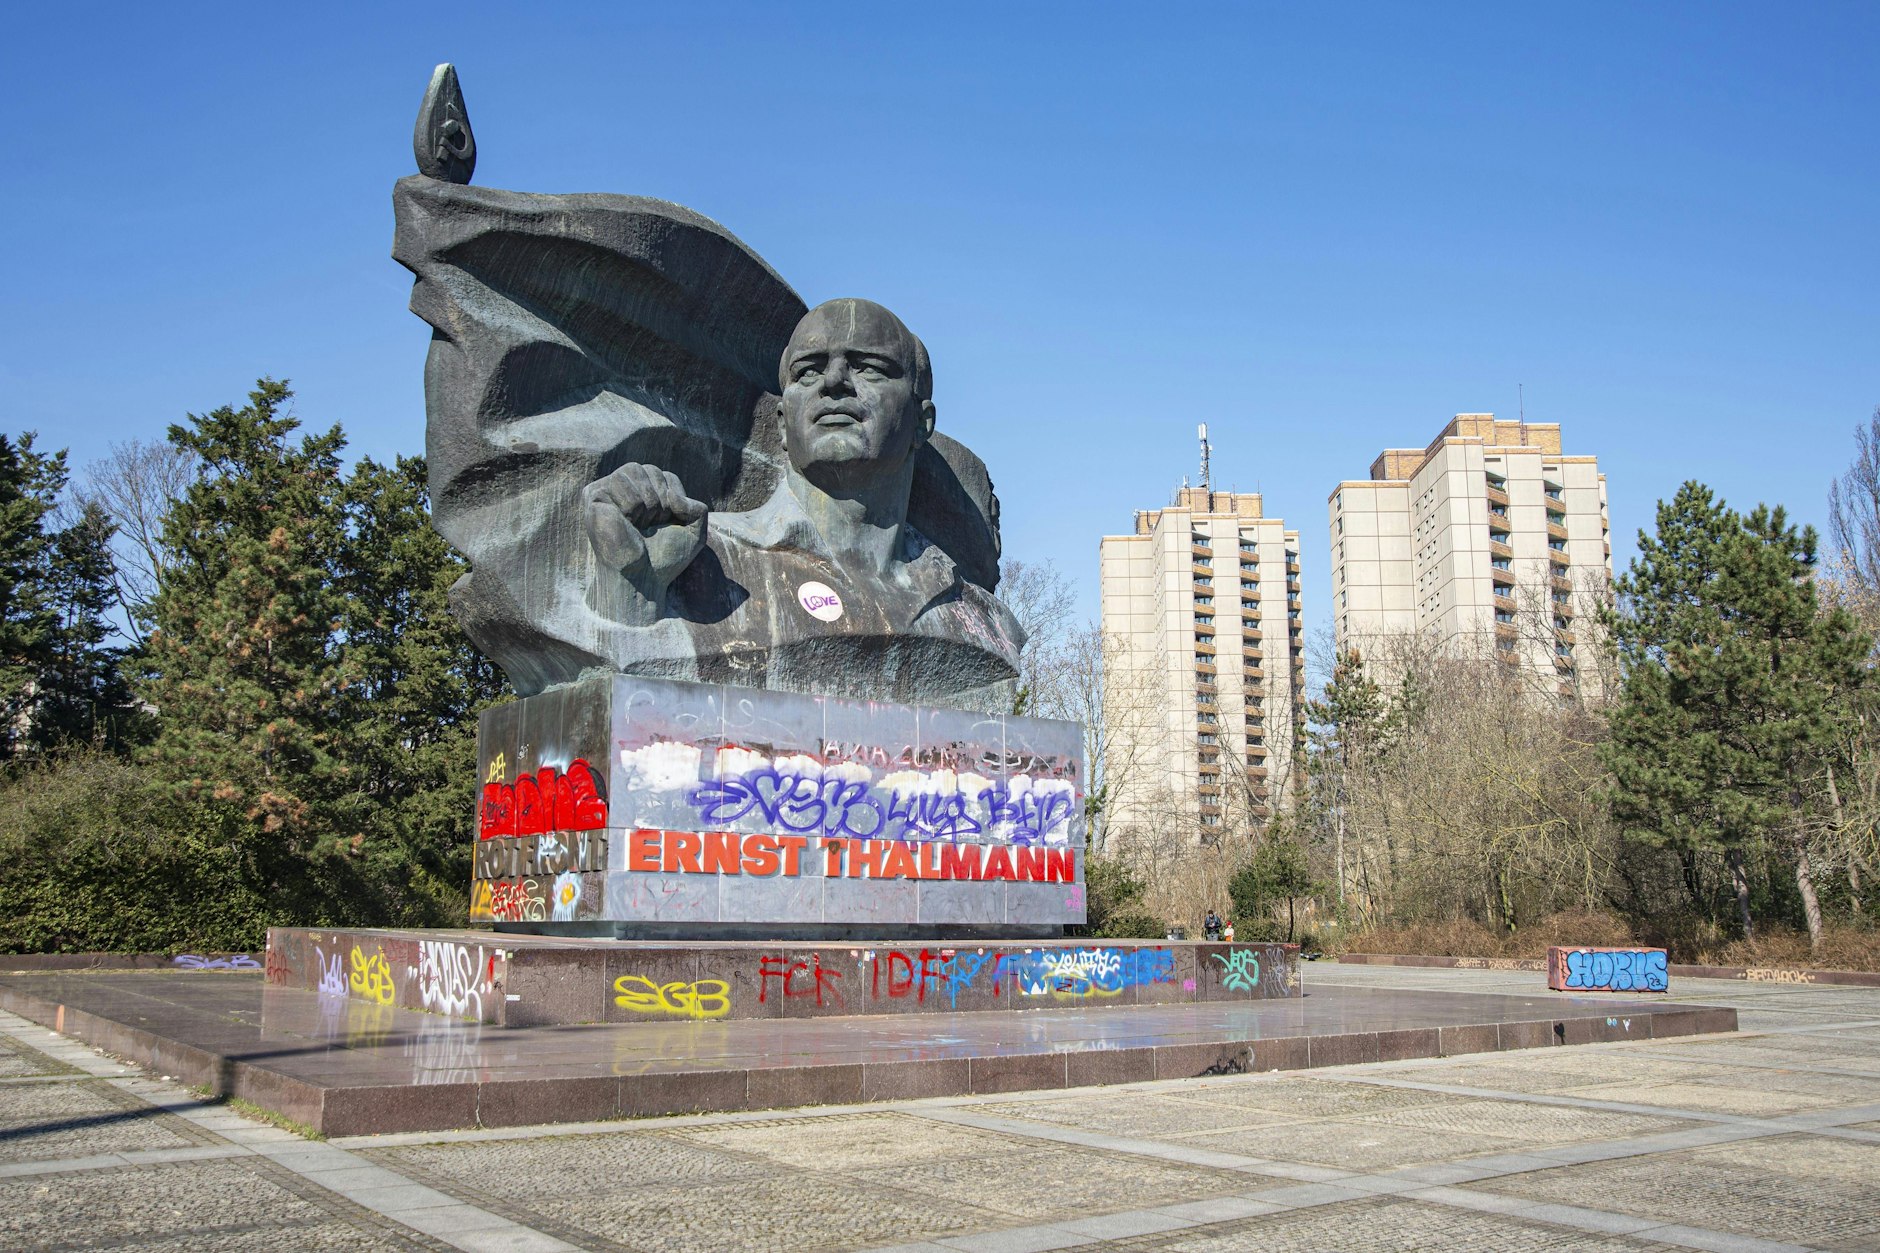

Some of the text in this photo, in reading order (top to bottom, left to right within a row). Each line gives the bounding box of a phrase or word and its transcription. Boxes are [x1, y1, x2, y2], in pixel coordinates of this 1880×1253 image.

[804, 596, 838, 610] LOVE
[628, 829, 1075, 883] ERNST THÄLMANN
[759, 951, 845, 1009] FCK
[870, 948, 949, 1007] IDF
[1565, 951, 1668, 991] HORUS
[613, 974, 732, 1020] SGB
